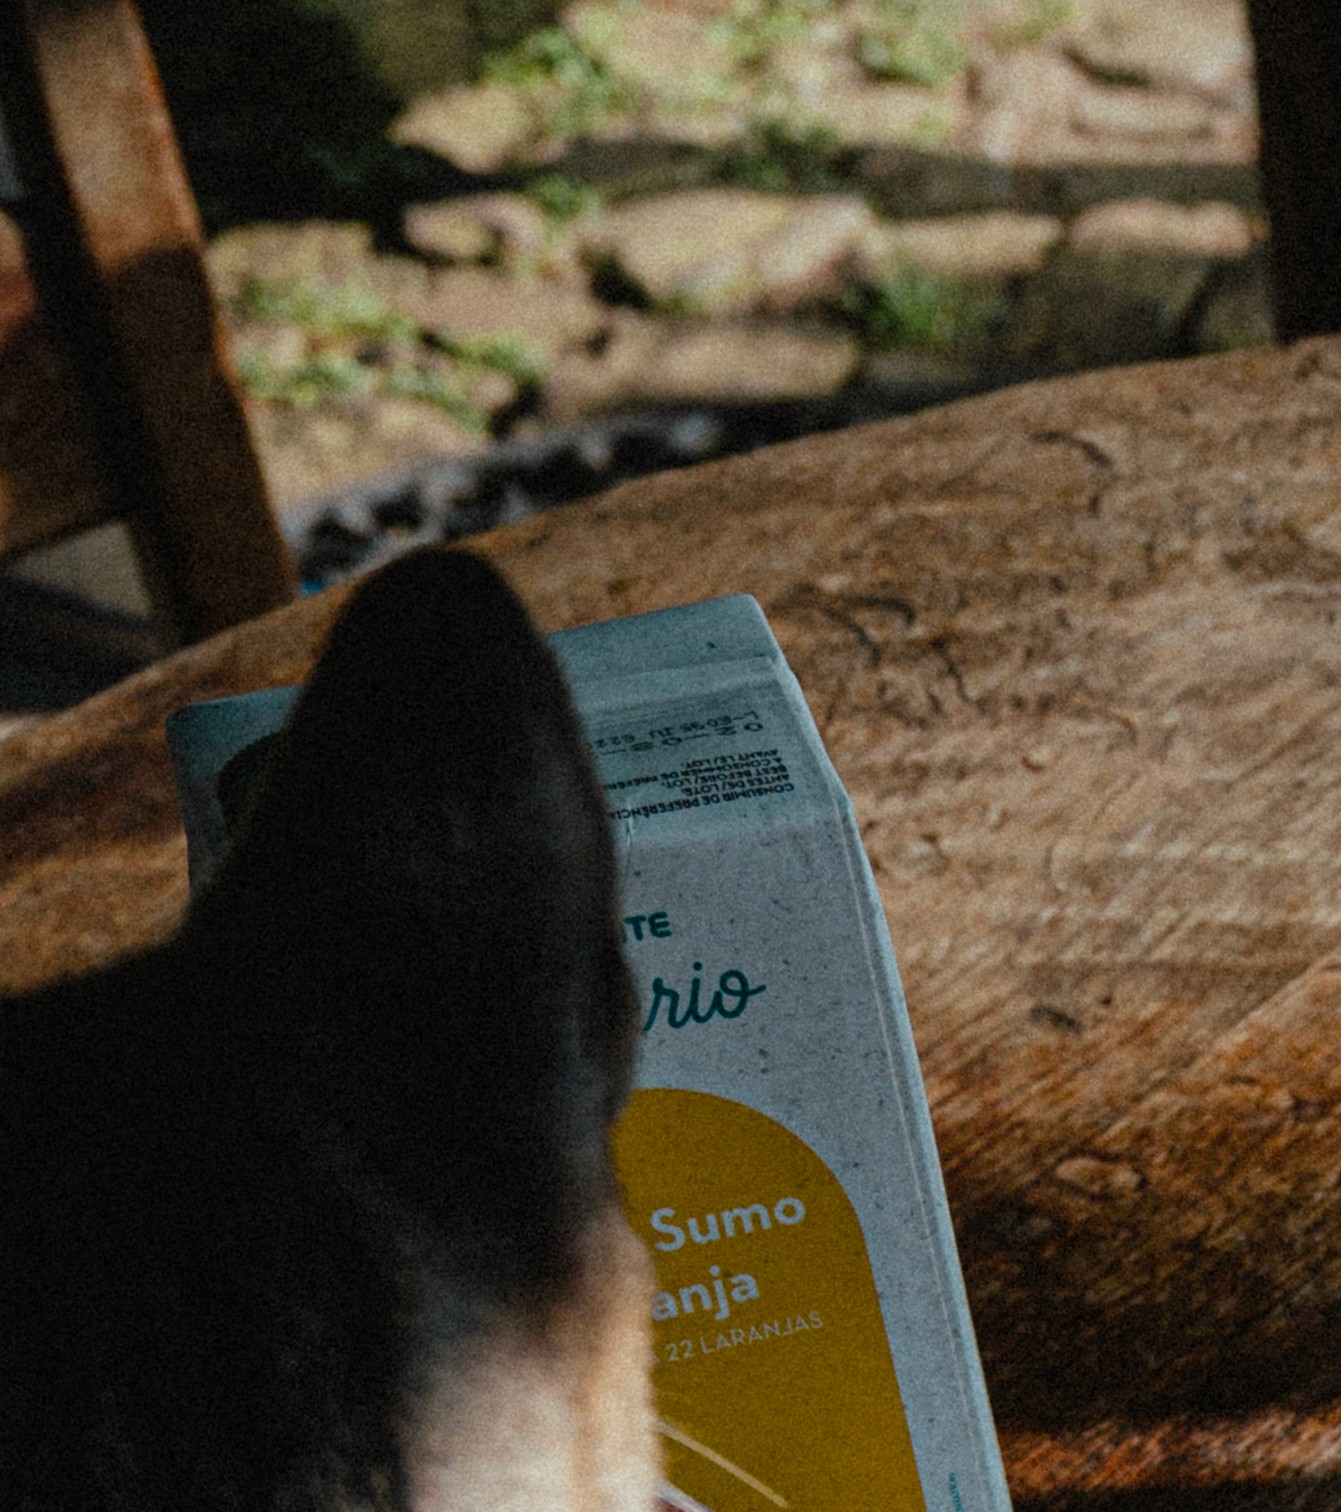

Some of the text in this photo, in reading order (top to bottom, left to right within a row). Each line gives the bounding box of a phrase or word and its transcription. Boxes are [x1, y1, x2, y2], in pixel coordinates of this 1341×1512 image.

[739, 749, 778, 762] AVANT
[661, 771, 680, 780] DE
[755, 764, 787, 777] BEST
[750, 773, 790, 788] ANTES
[702, 793, 720, 806] DE
[723, 783, 795, 802] CONSUMIR
[622, 911, 672, 943] TE
[644, 961, 766, 1032] rio
[650, 1196, 806, 1253] Sumo
[651, 1264, 760, 1322] anja
[665, 1310, 824, 1362] 22 LARANJAS
